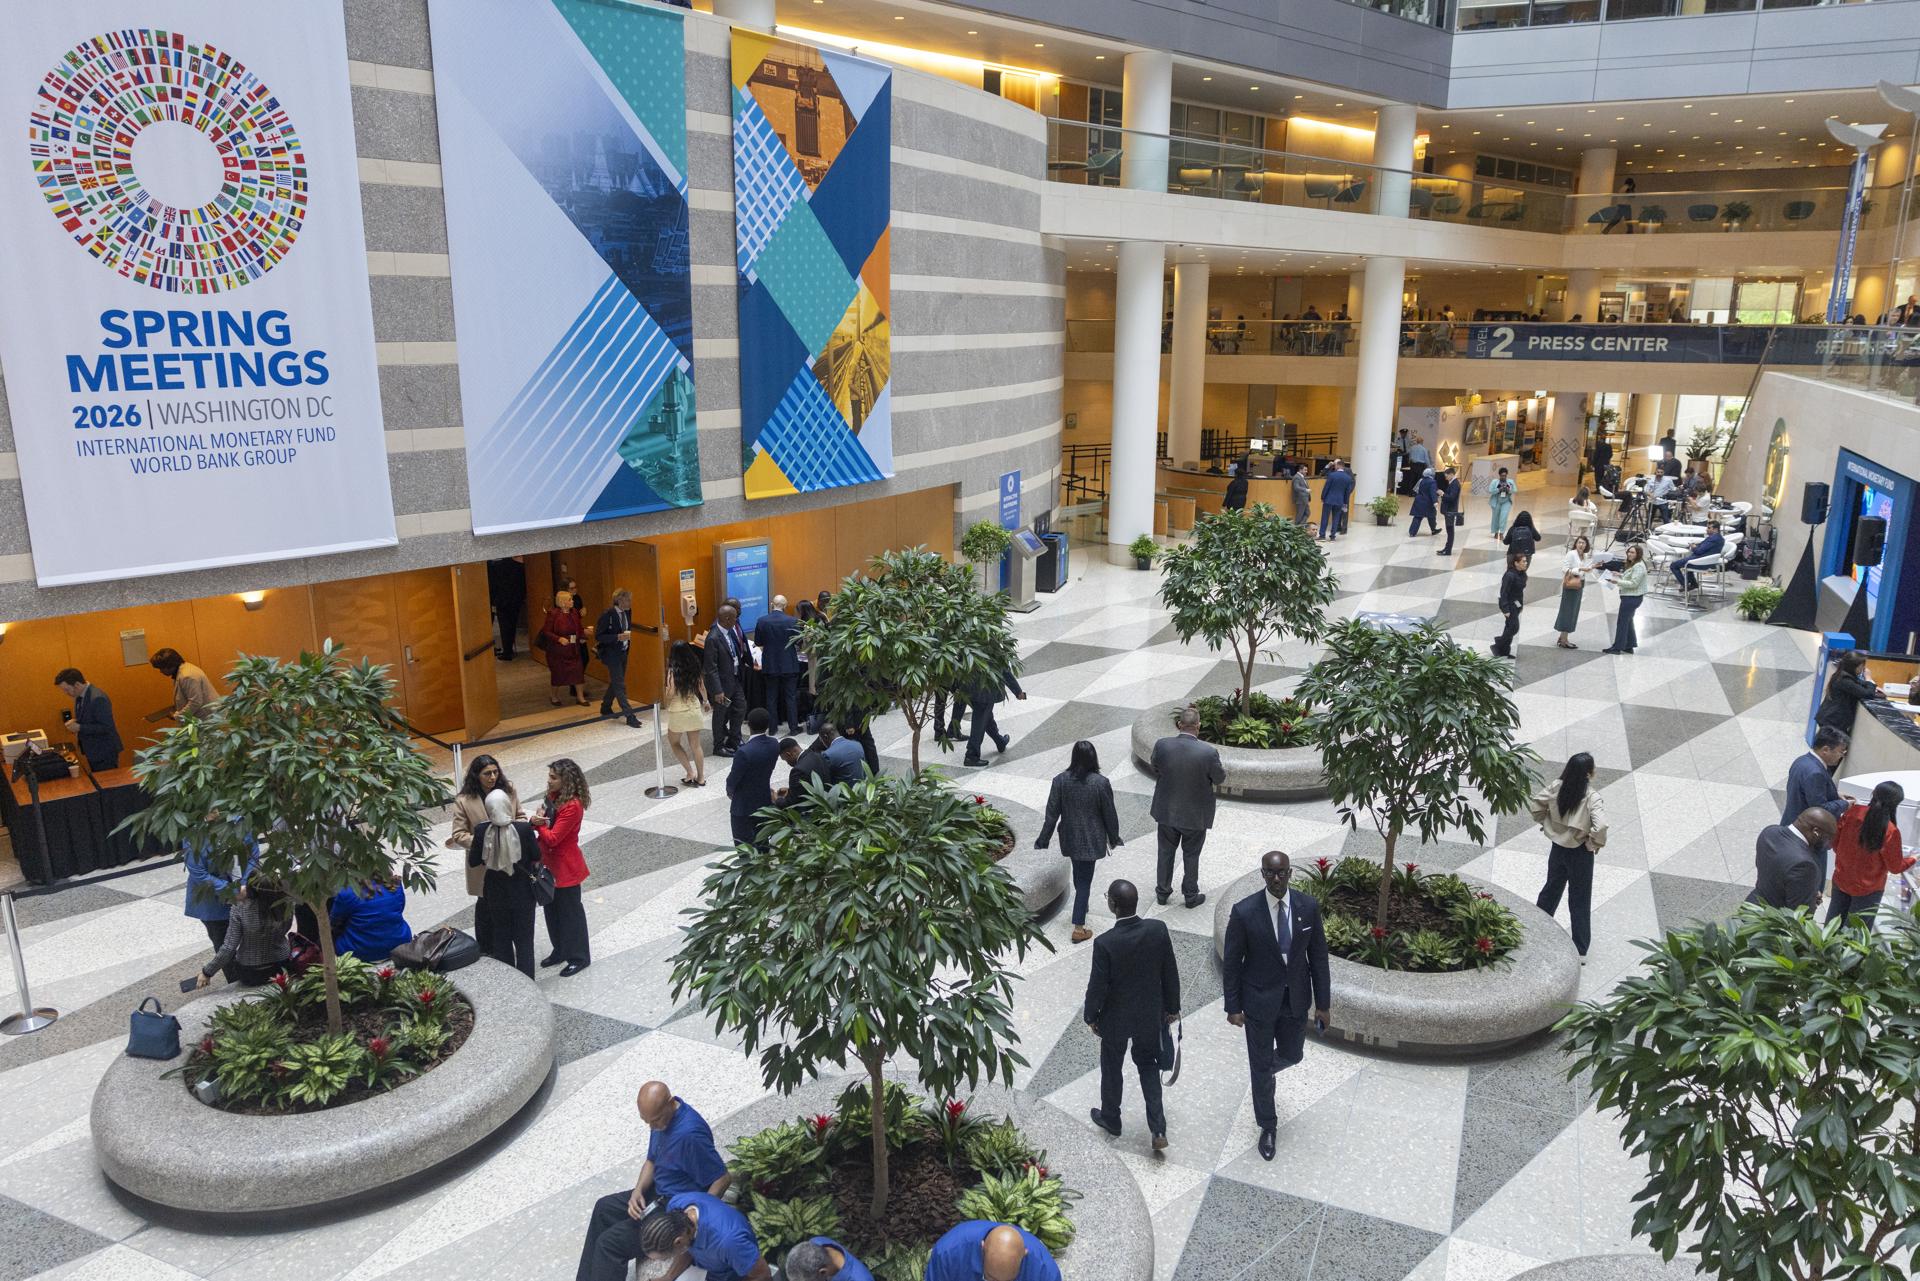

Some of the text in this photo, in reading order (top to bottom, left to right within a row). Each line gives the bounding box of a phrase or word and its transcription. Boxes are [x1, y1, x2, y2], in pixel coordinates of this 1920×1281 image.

[99, 308, 291, 348] SPRING
[1476, 327, 1488, 358] LEVEL
[1490, 327, 1669, 358] 2 PRESS CENTER
[66, 349, 330, 393] MEETINGS
[71, 396, 334, 429] 2026 WASHINGTON DC
[76, 426, 336, 457] INTERNATIONAL MONETARY FUND
[130, 447, 297, 474] WORLD BANK GROUP
